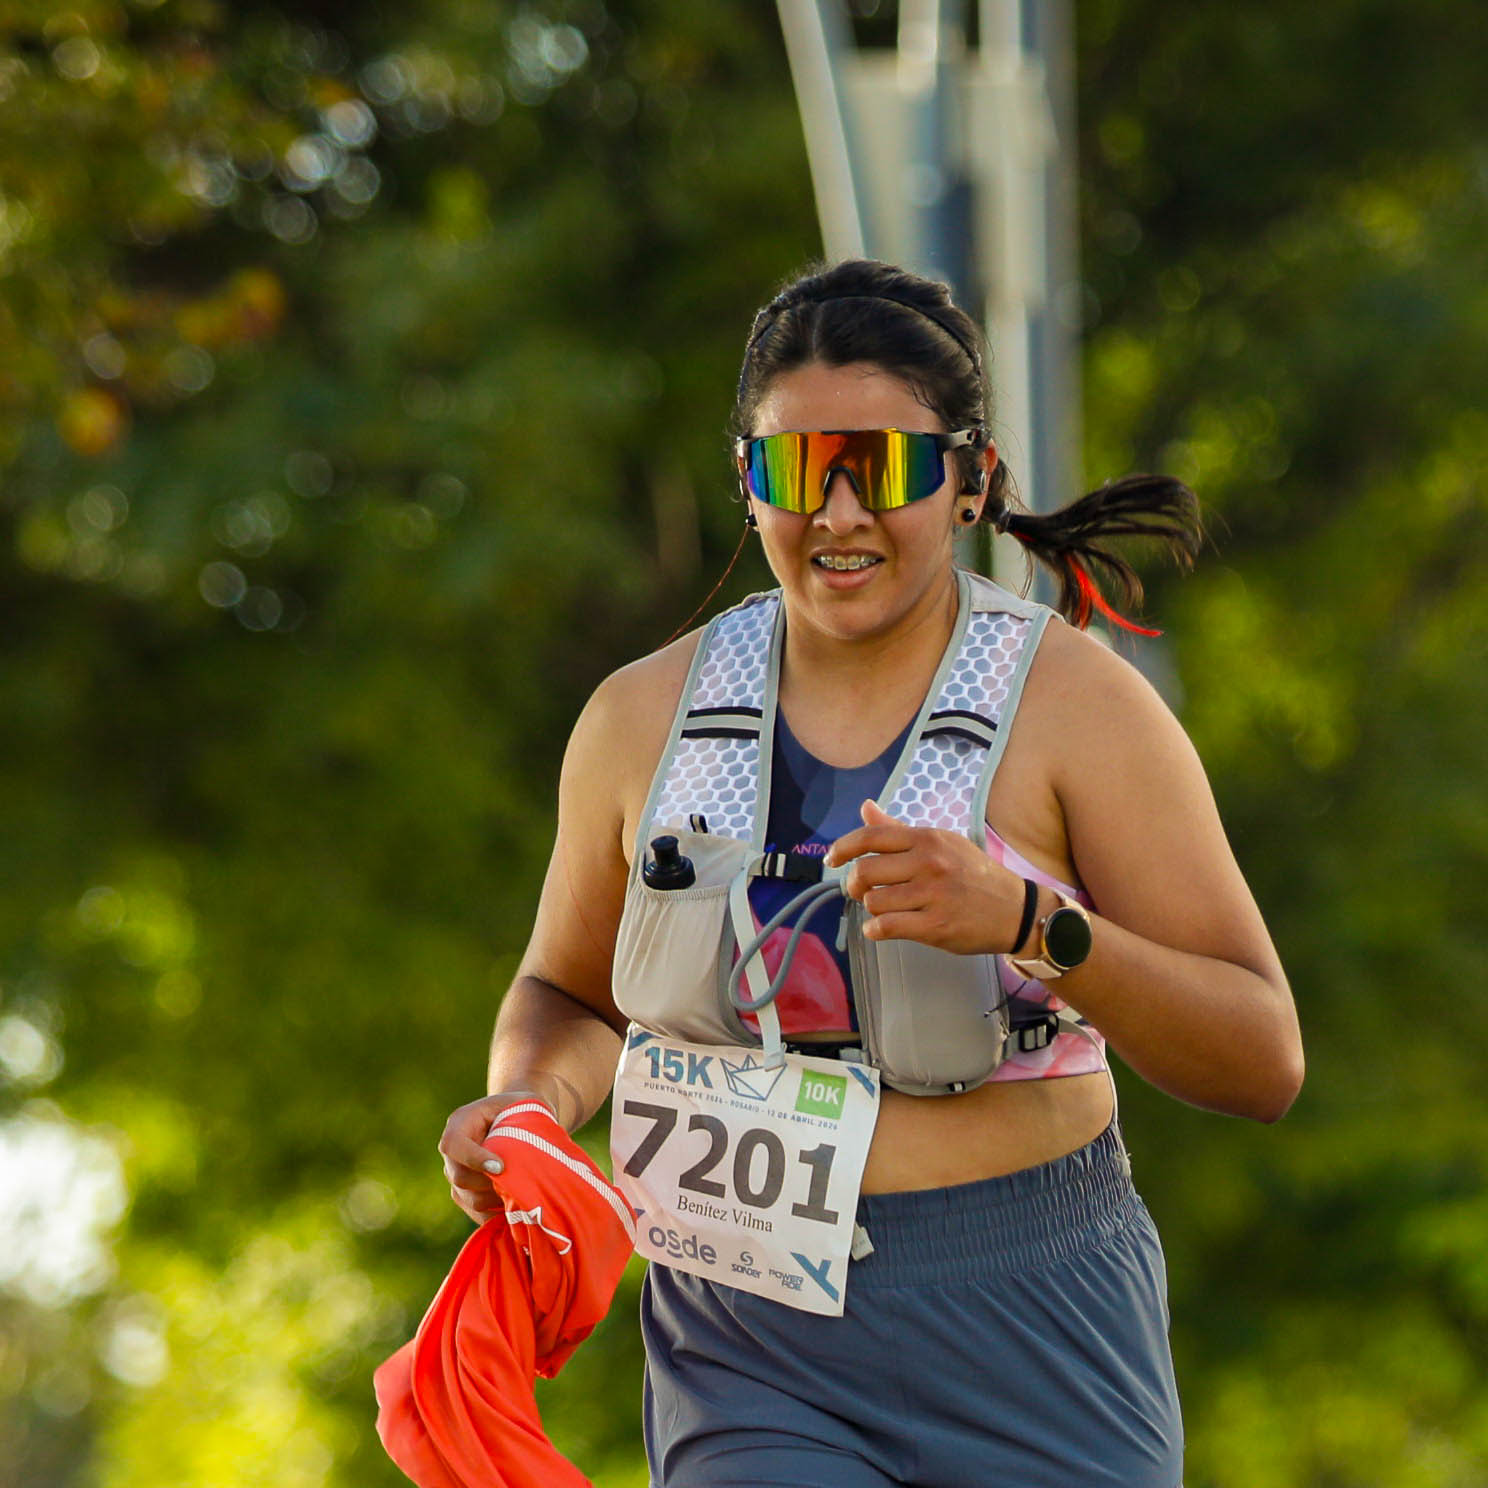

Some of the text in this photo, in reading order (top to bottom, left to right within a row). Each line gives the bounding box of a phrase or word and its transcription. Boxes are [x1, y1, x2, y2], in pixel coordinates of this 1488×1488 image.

[645, 1046, 713, 1089] 15K
[644, 1082, 675, 1093] PUERTO
[677, 1089, 702, 1099] NORTE
[730, 1100, 760, 1113] ROSARIO
[791, 1114, 814, 1126] ABRIL
[803, 1080, 841, 1105] 10K
[623, 1100, 839, 1225] 7201
[677, 1194, 773, 1233] Benítez Vilma
[648, 1226, 717, 1265] osde
